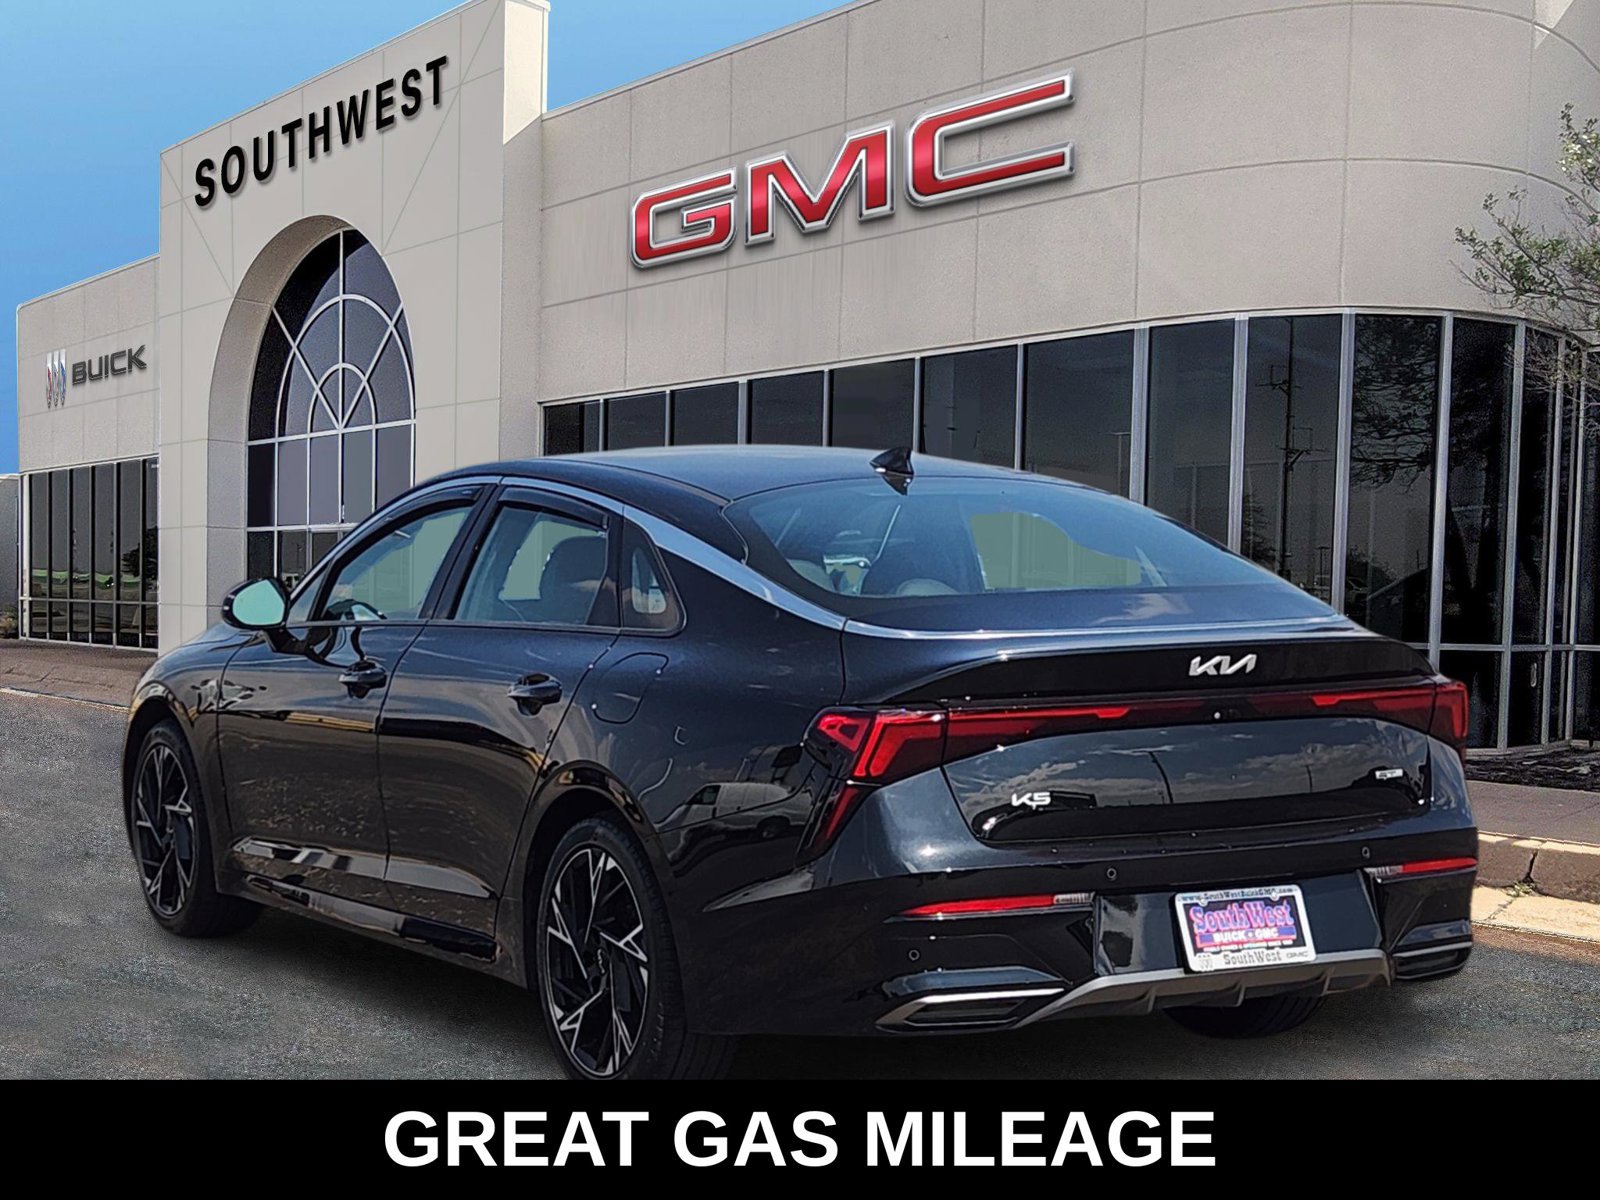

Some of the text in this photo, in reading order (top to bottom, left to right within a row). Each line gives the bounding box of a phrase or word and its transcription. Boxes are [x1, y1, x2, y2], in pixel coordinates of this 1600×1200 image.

[194, 55, 448, 207] SOUTHWEST
[630, 69, 1076, 269] GMC
[72, 344, 147, 386] BUICK
[1188, 653, 1257, 676] KIA
[1011, 791, 1051, 807] K5
[1189, 900, 1295, 934] SouthWest
[1213, 927, 1279, 943] BUICK GMC
[1223, 949, 1283, 966] SouthWest
